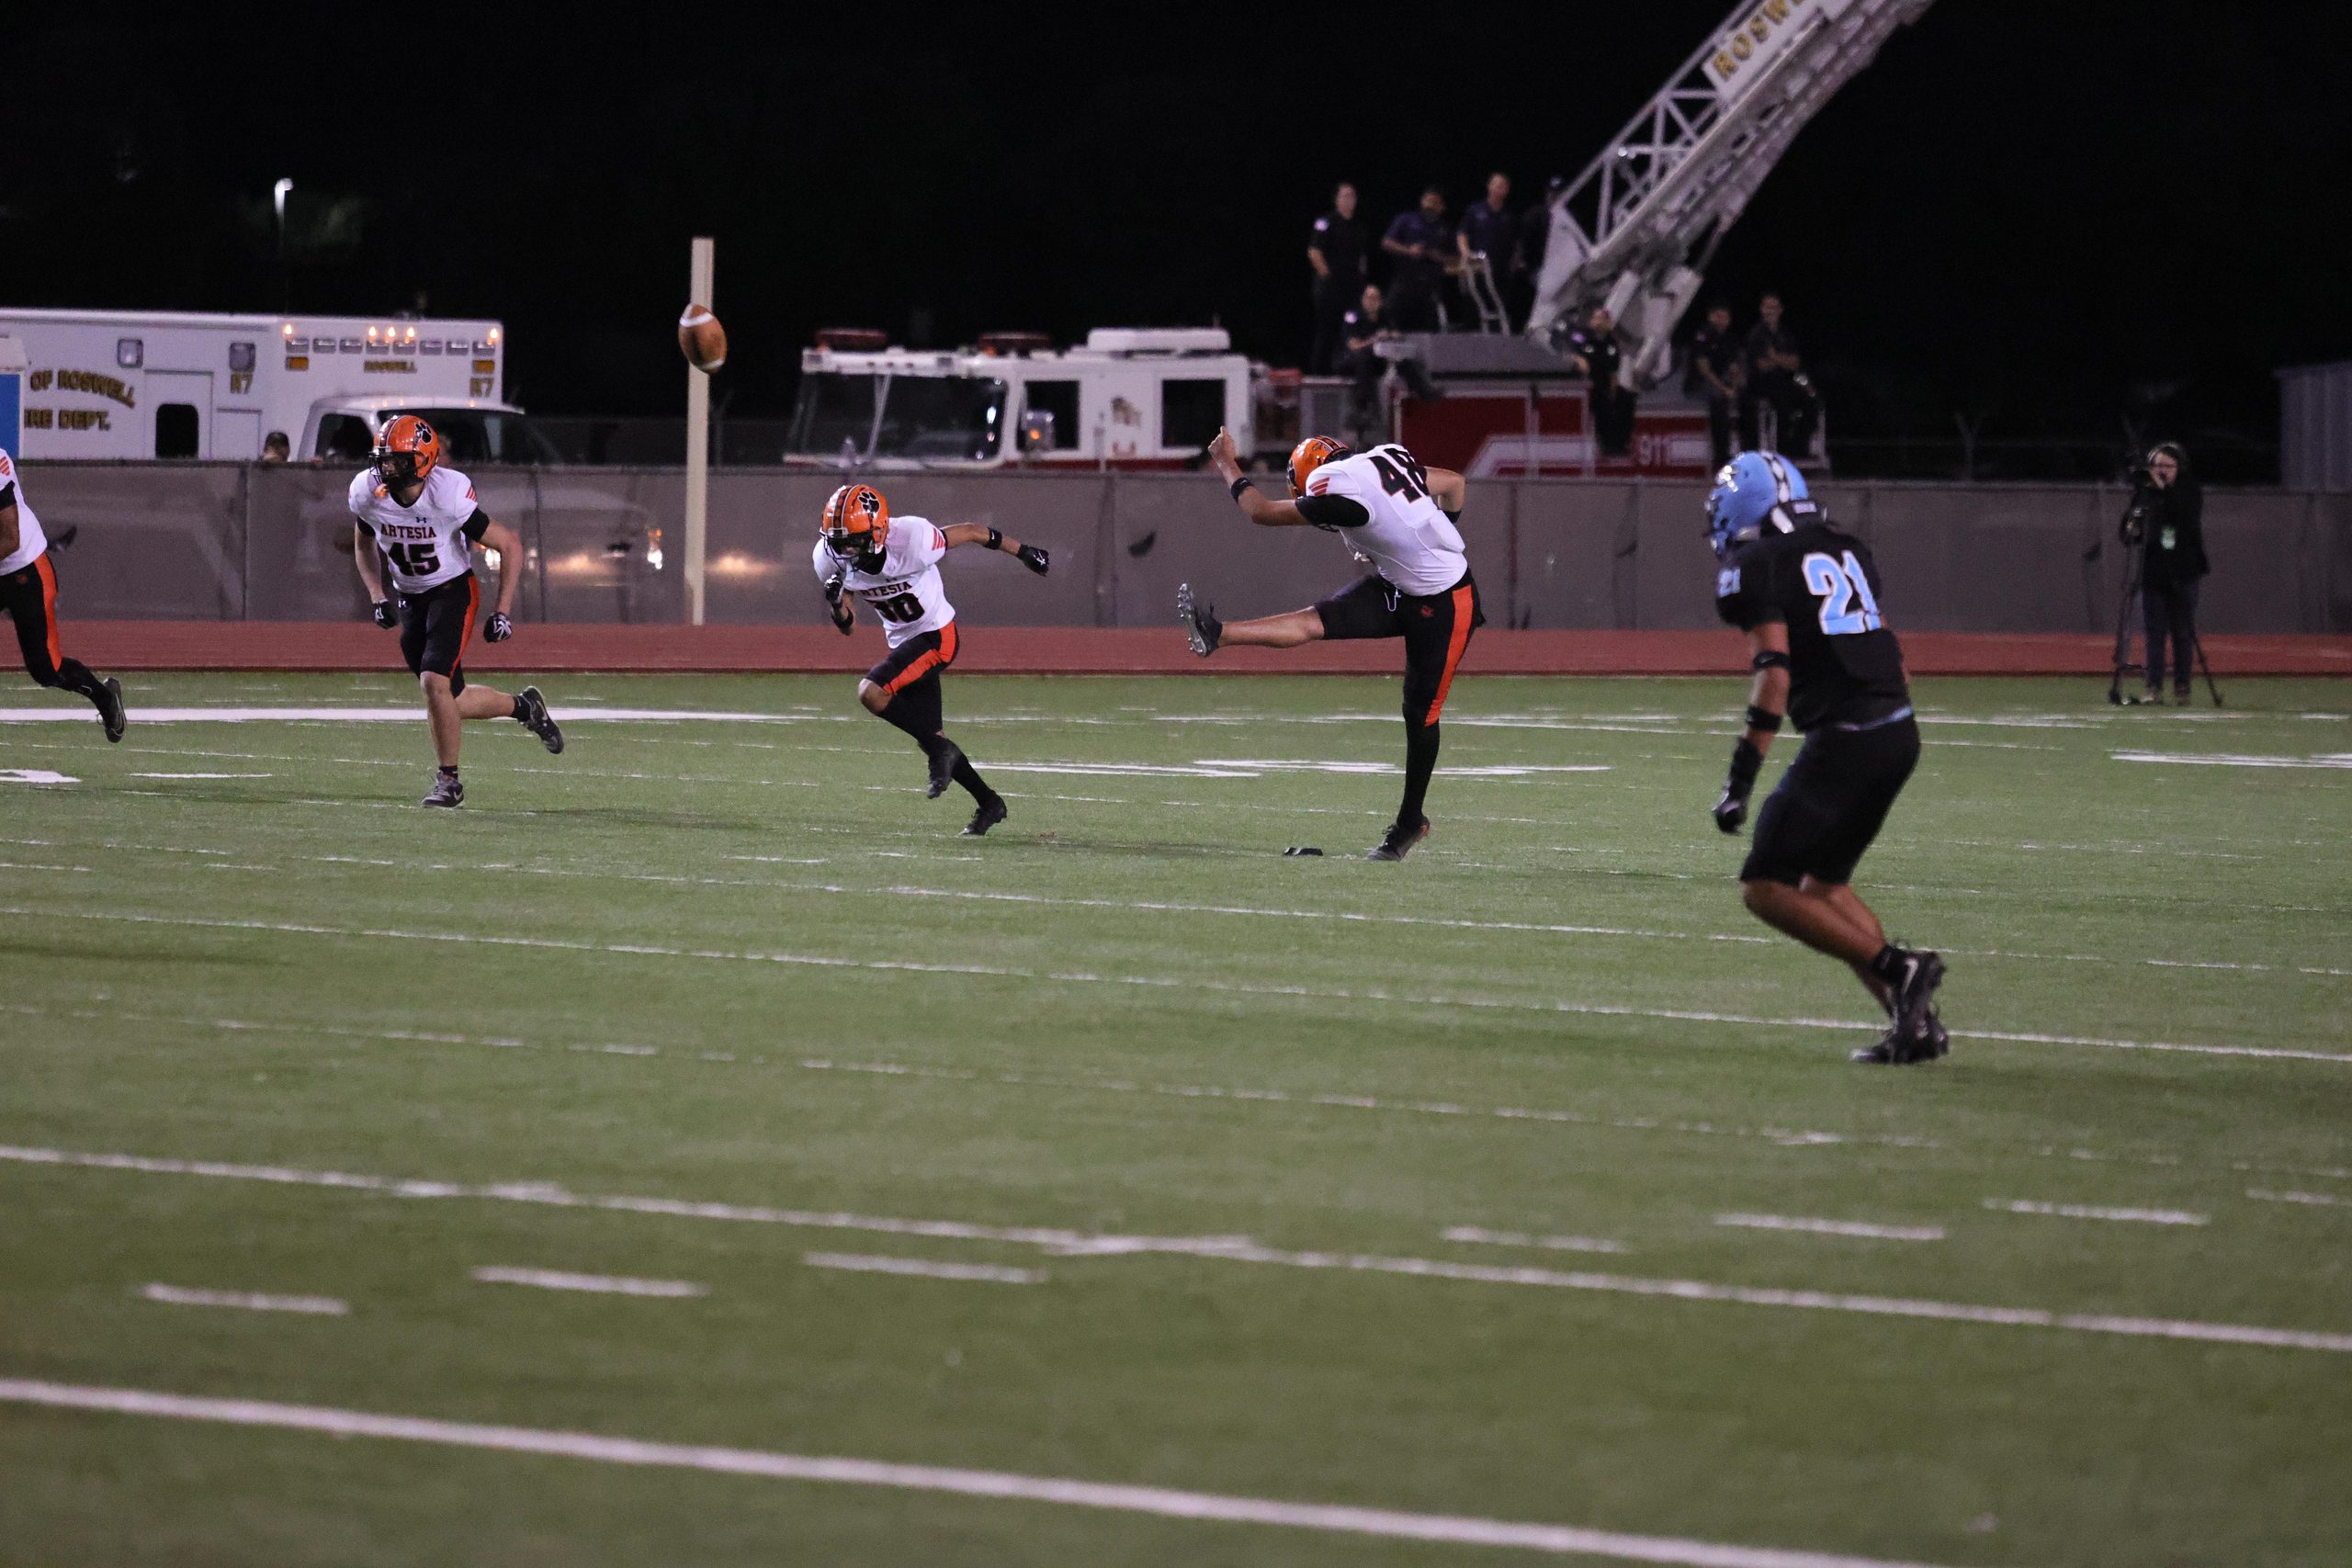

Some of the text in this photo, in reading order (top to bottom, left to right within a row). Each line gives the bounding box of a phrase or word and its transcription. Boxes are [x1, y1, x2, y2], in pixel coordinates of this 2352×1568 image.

[1713, 0, 1802, 83] ROSW
[30, 370, 135, 408] OF ROSWELL
[24, 409, 111, 431] IRE DEPT.
[380, 524, 437, 539] ARTESIA
[389, 542, 441, 576] 45
[1802, 550, 1882, 632] 21
